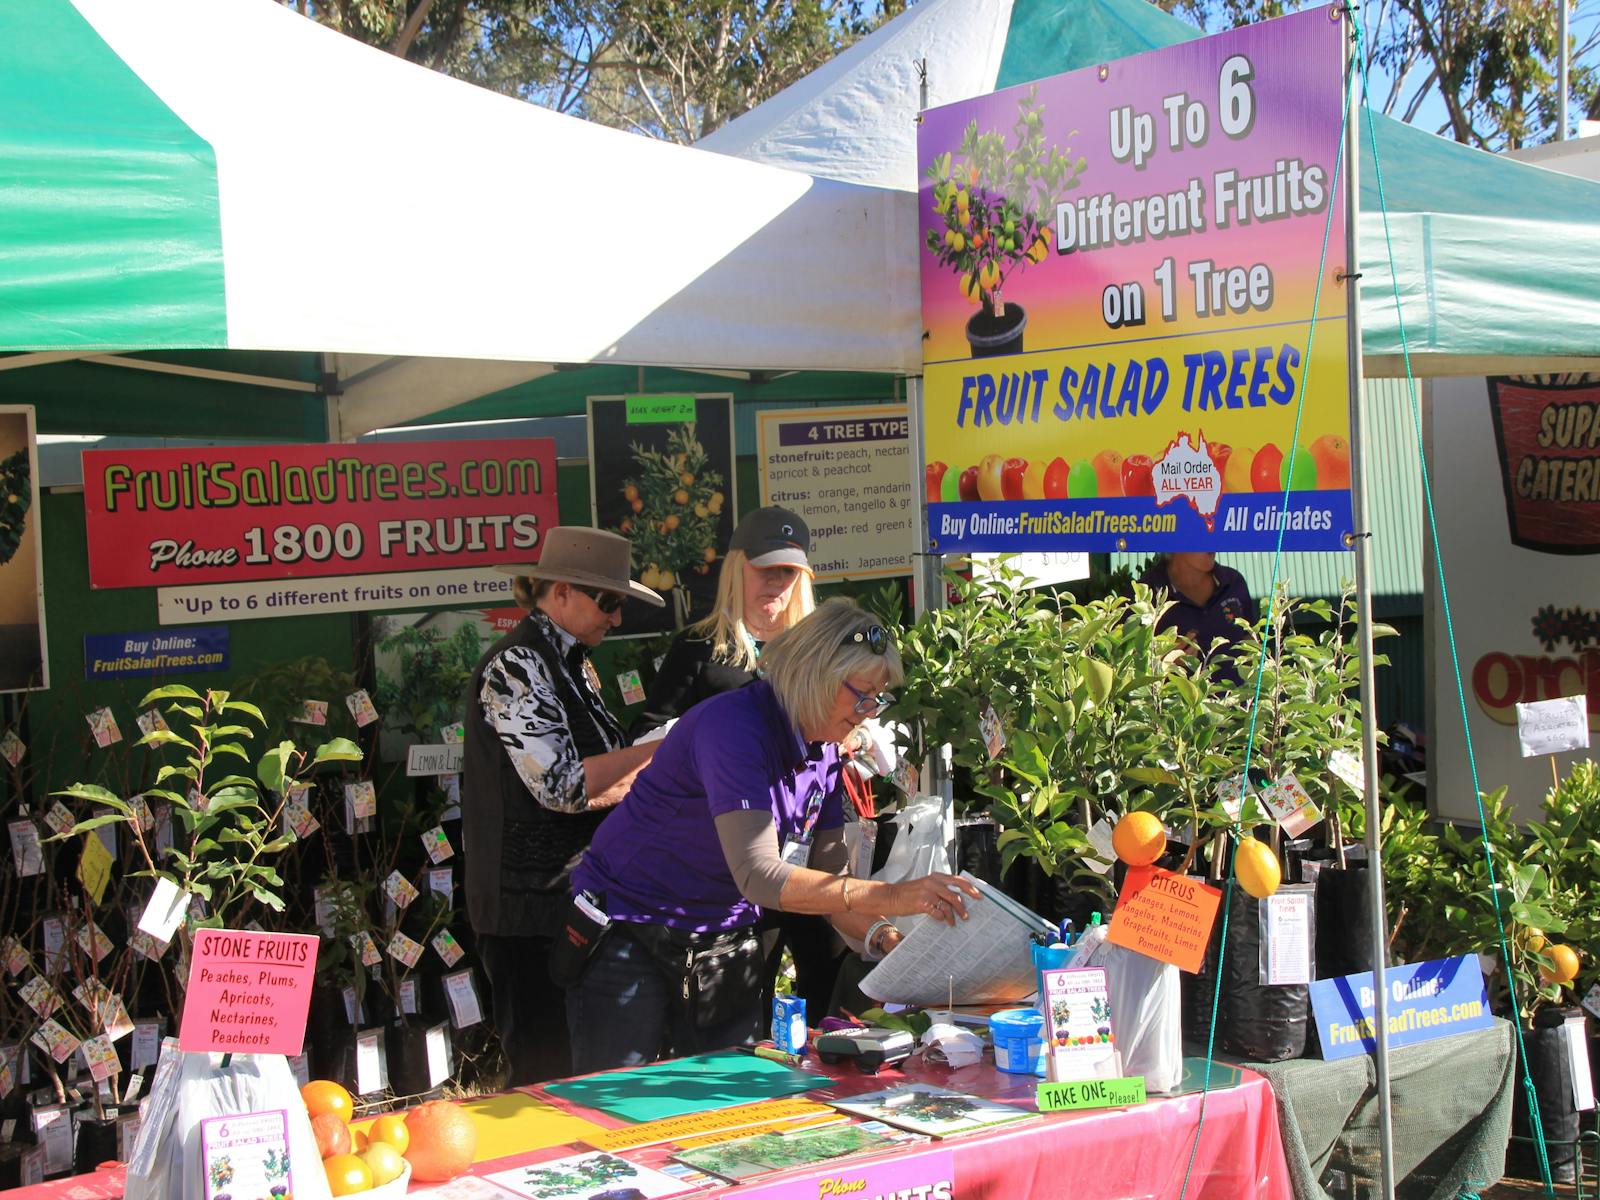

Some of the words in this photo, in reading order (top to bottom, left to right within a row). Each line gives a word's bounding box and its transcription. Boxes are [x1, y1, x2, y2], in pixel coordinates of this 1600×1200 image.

[1109, 105, 1154, 168] Up
[1163, 94, 1206, 148] To
[1219, 55, 1254, 138] 6
[1056, 179, 1205, 252] Different
[1214, 160, 1325, 224] Fruits
[1103, 281, 1143, 327] on
[1154, 258, 1177, 318] 1
[1188, 262, 1272, 316] Tree
[957, 368, 1049, 428] FRUIT
[1052, 357, 1170, 421] SALAD
[1182, 343, 1300, 412] TREES
[808, 425, 820, 441] 4
[823, 423, 865, 440] TREE
[768, 449, 835, 464] stonefruit:
[836, 446, 871, 462] peach,
[769, 465, 809, 480] apricot
[812, 465, 821, 477] &
[823, 463, 872, 478] peachcot
[1160, 461, 1182, 475] Mail
[1184, 460, 1213, 475] Order
[104, 457, 542, 512] FruitSaladTrees.com
[1160, 477, 1182, 491] ALL
[1184, 476, 1214, 490] YEAR
[770, 489, 811, 503] citrus:
[818, 487, 860, 500] orange,
[803, 504, 841, 516] lemon,
[844, 498, 886, 513] tangello
[889, 498, 898, 509] &
[941, 514, 967, 538] Buy
[1224, 506, 1249, 531] All
[1253, 505, 1332, 532] climates
[811, 524, 848, 540] apple:
[851, 522, 869, 535] red
[876, 521, 905, 535] green
[149, 539, 239, 571] Phone
[243, 521, 364, 566] 1800
[378, 514, 540, 558] FRUITS
[813, 558, 849, 573] nashi:
[858, 555, 905, 570] Japanese
[219, 594, 240, 612] to
[246, 595, 258, 610] 6
[265, 587, 349, 607] different
[354, 583, 403, 601] fruits
[409, 584, 430, 599] on
[436, 580, 468, 597] one
[497, 617, 521, 630] ESPA
[124, 639, 149, 655] Buy
[152, 636, 197, 651] Online:
[93, 653, 223, 673] FruitSaladTrees.com
[1150, 874, 1195, 901] CITRUS
[202, 936, 252, 958] STONE
[257, 939, 309, 962] FRUITS
[200, 968, 252, 986] Peaches,
[258, 971, 298, 988] Plums,
[1057, 974, 1066, 987] 6
[219, 989, 275, 1007] Apricots,
[1392, 977, 1445, 1003] Online:
[210, 1009, 278, 1028] Nectarines,
[1330, 1000, 1483, 1046] FruitSadTrees.com
[212, 1029, 270, 1045] Peachcots
[1045, 1087, 1077, 1109] TAKE
[1081, 1081, 1107, 1100] ONE
[1109, 1089, 1140, 1105] Please!
[219, 1123, 229, 1138] 6
[818, 1177, 867, 1200] Phone
